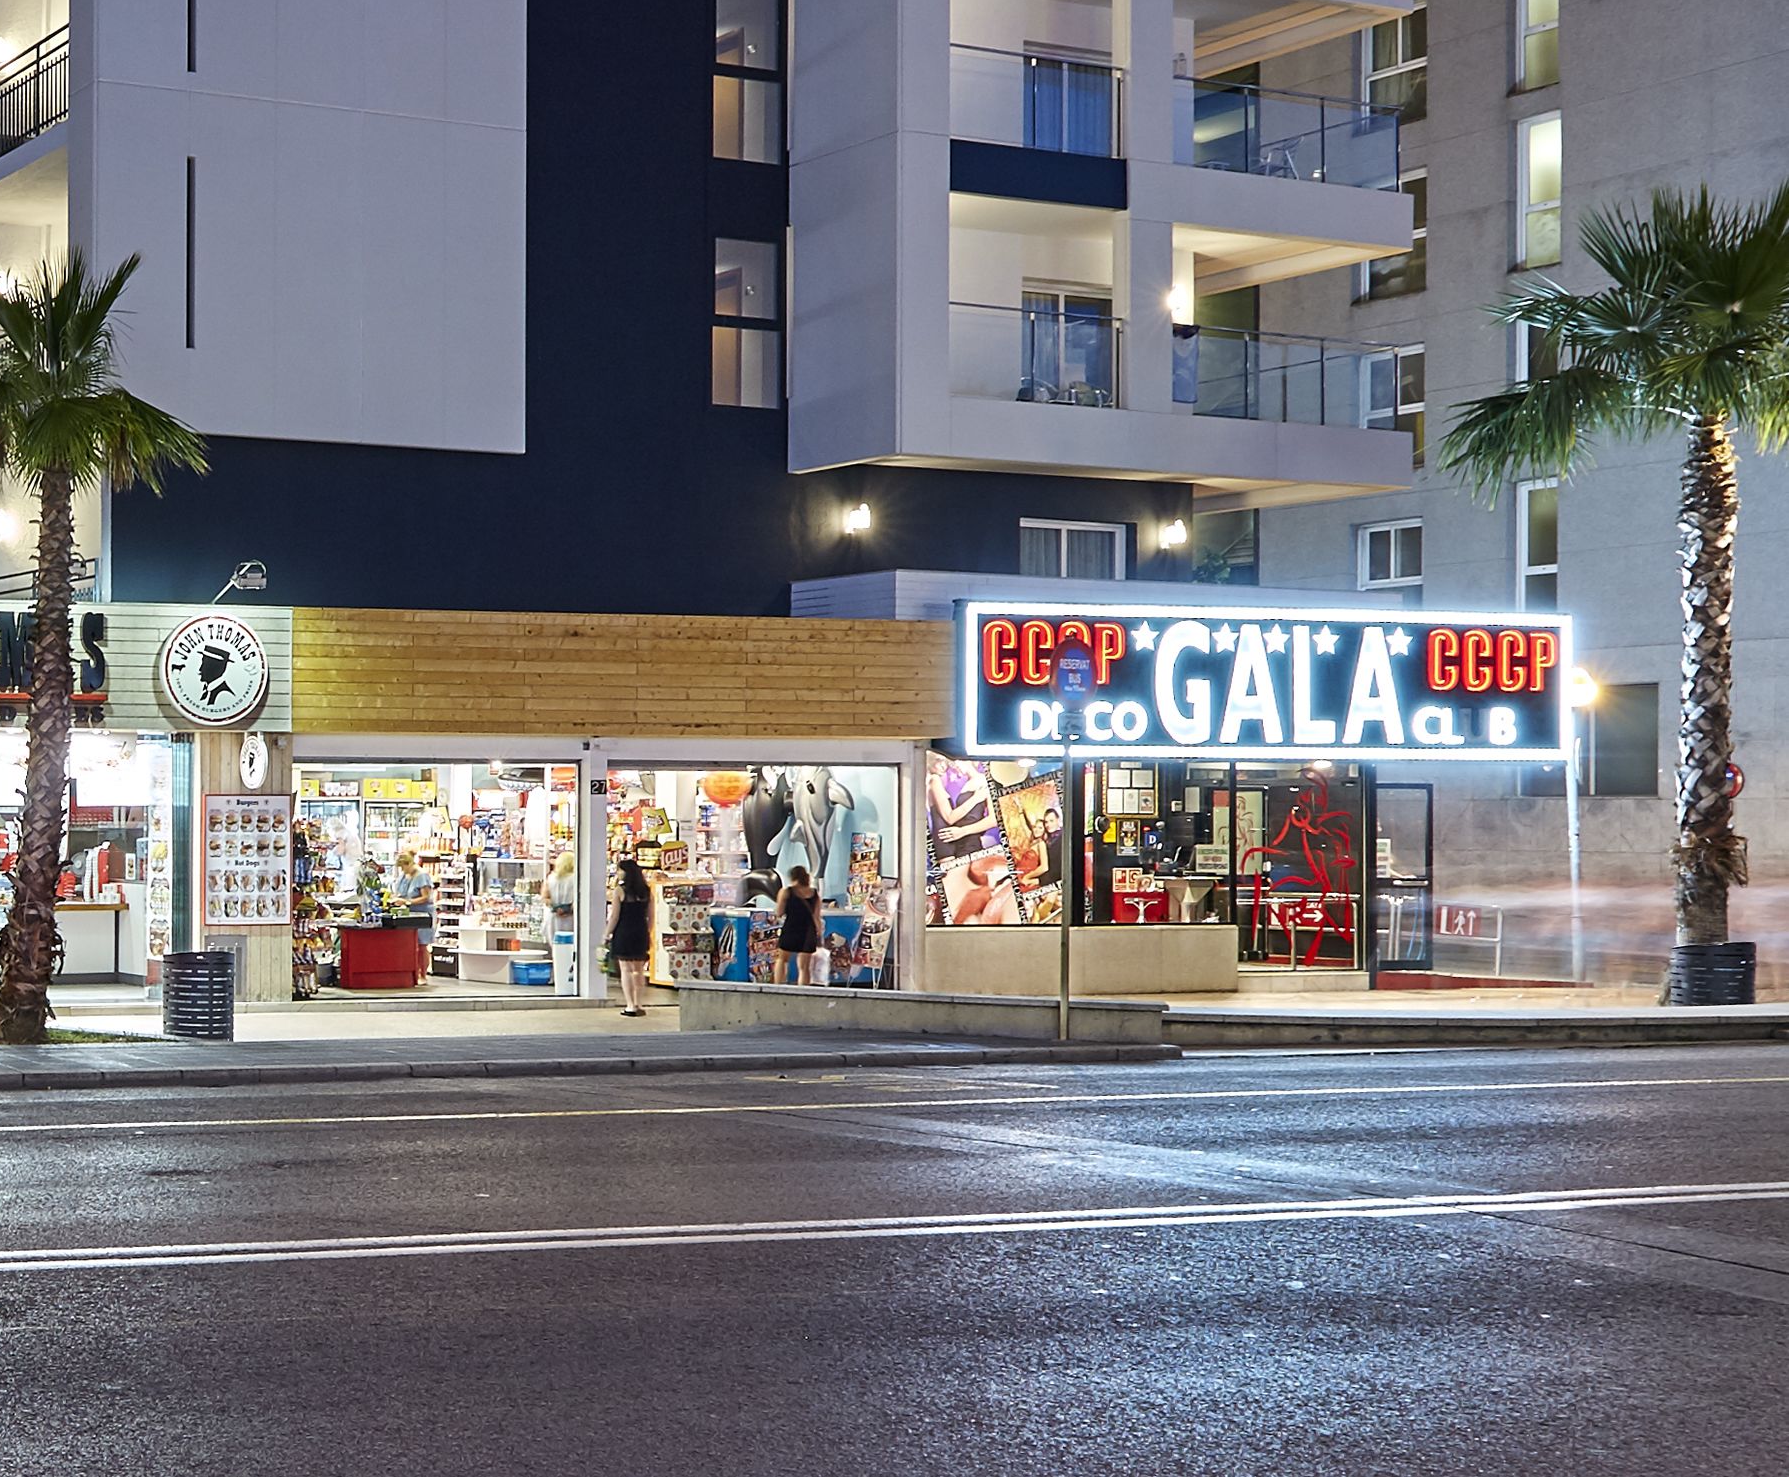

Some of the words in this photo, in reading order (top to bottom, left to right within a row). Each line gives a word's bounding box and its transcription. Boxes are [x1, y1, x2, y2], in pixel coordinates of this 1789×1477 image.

[175, 627, 205, 660] JOHN
[208, 624, 256, 661] THOMAS
[1426, 628, 1560, 693] CCCP
[1155, 619, 1405, 745] GALA
[1020, 699, 1148, 741] DICO
[592, 780, 606, 794] 27
